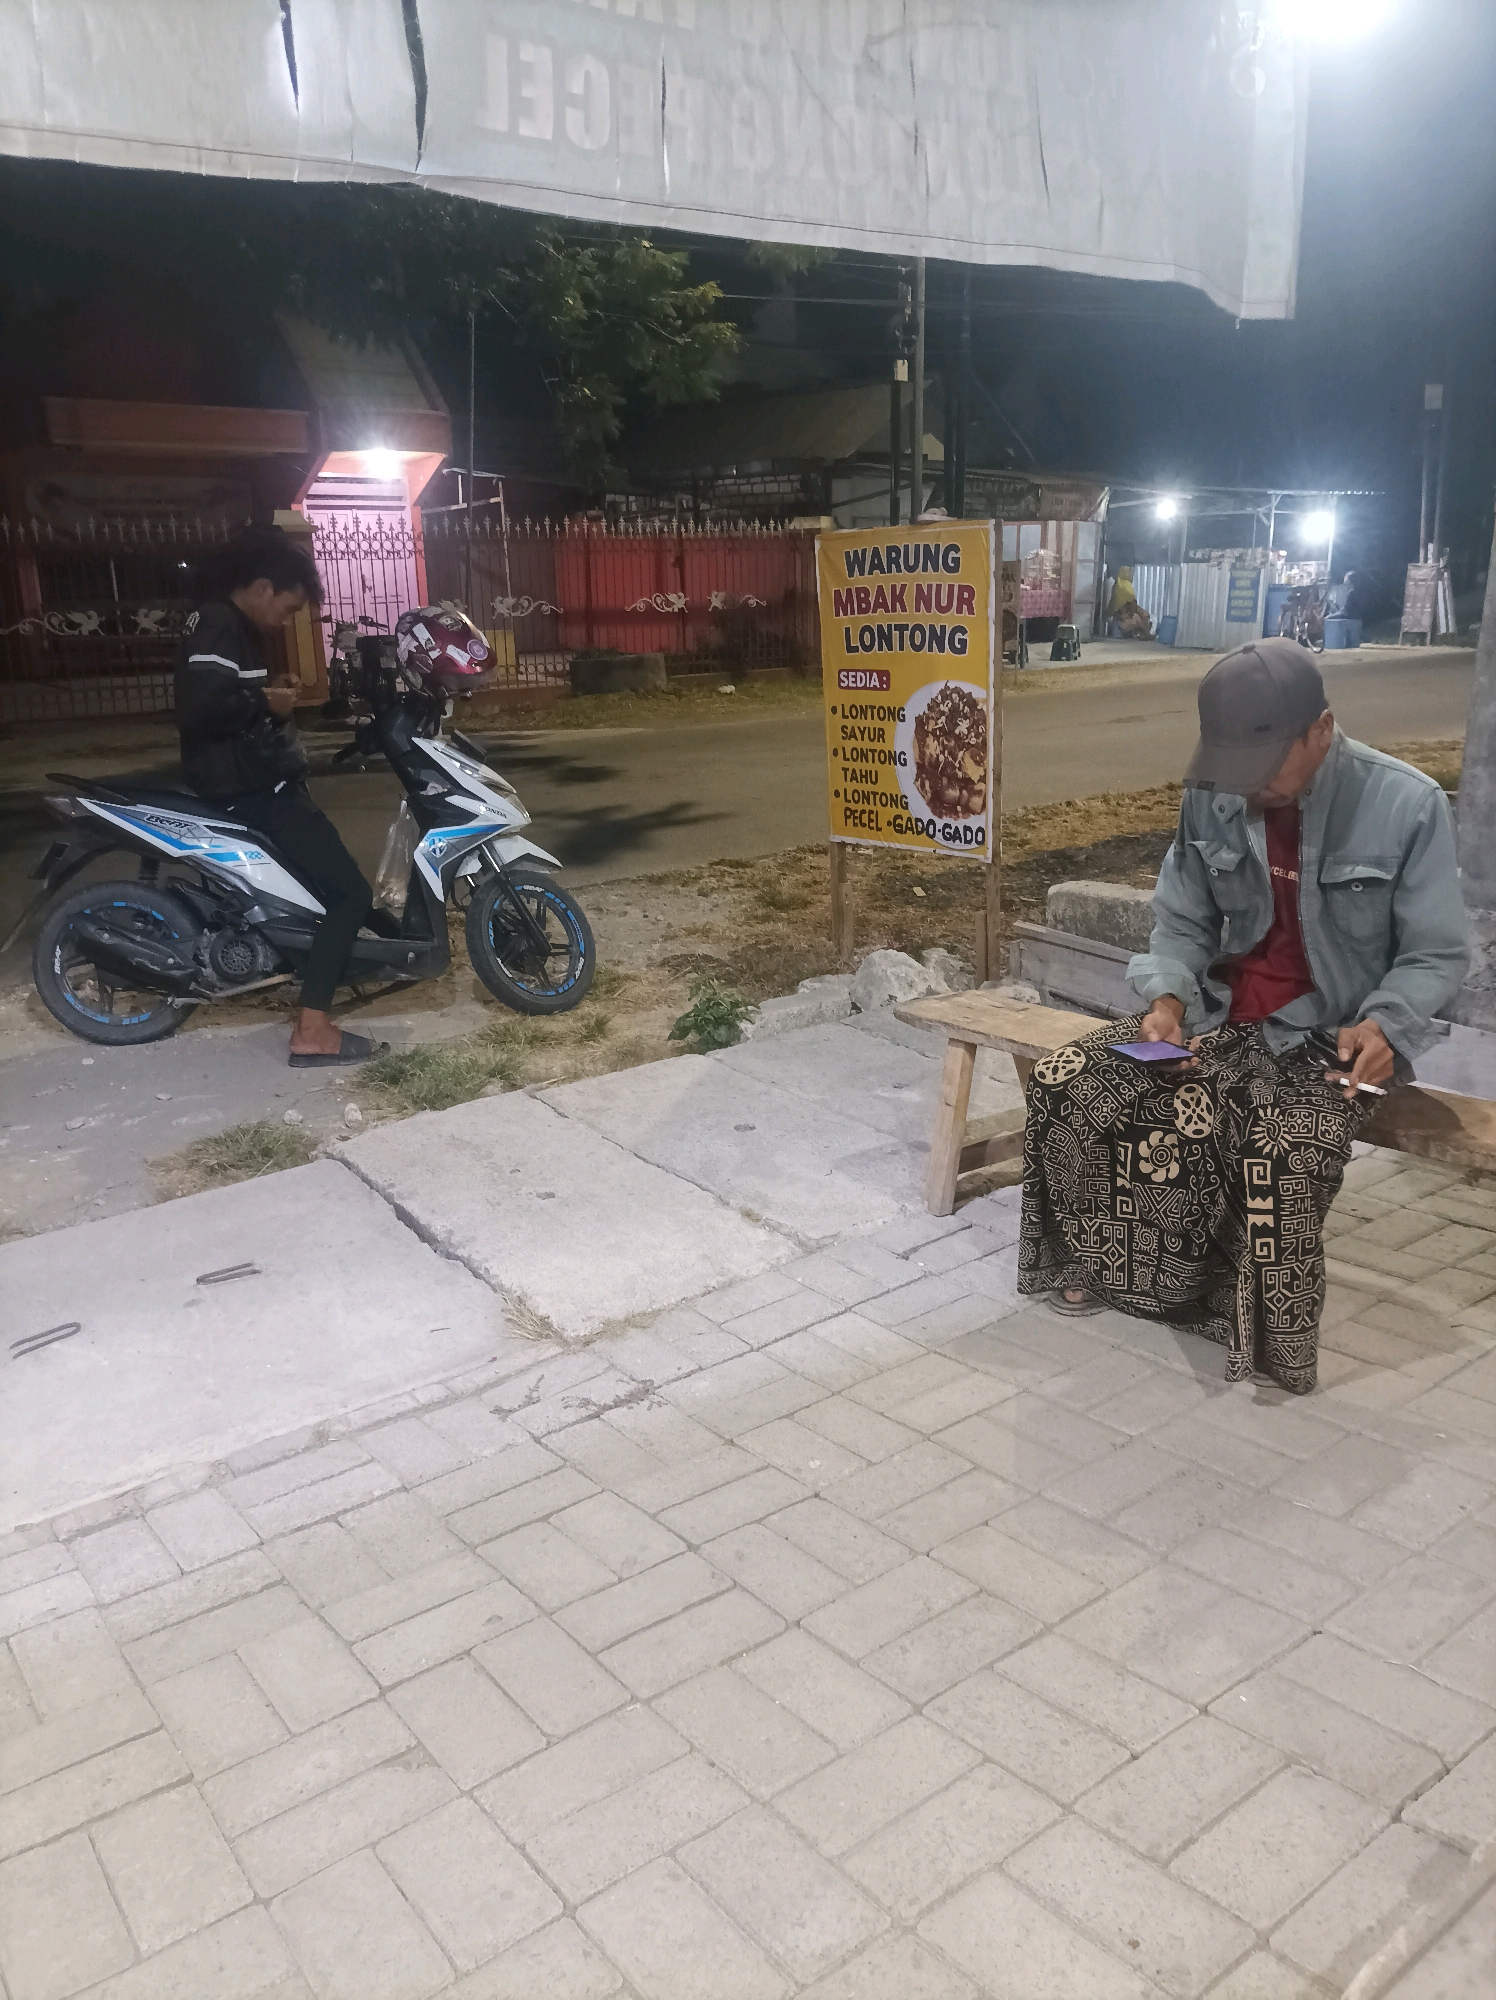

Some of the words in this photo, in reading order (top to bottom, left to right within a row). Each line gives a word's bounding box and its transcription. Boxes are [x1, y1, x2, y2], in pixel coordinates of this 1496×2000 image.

[844, 543, 961, 578] WARUNG
[833, 583, 908, 618] MBAK
[914, 583, 976, 616] NUR
[844, 623, 968, 655] LONTONG
[841, 704, 906, 722] LONTONG
[840, 725, 886, 743] SAYUR
[842, 747, 908, 766] LONTONG
[841, 767, 879, 785] TAHU
[843, 788, 909, 810] LONTONG
[844, 807, 882, 832] PECEL
